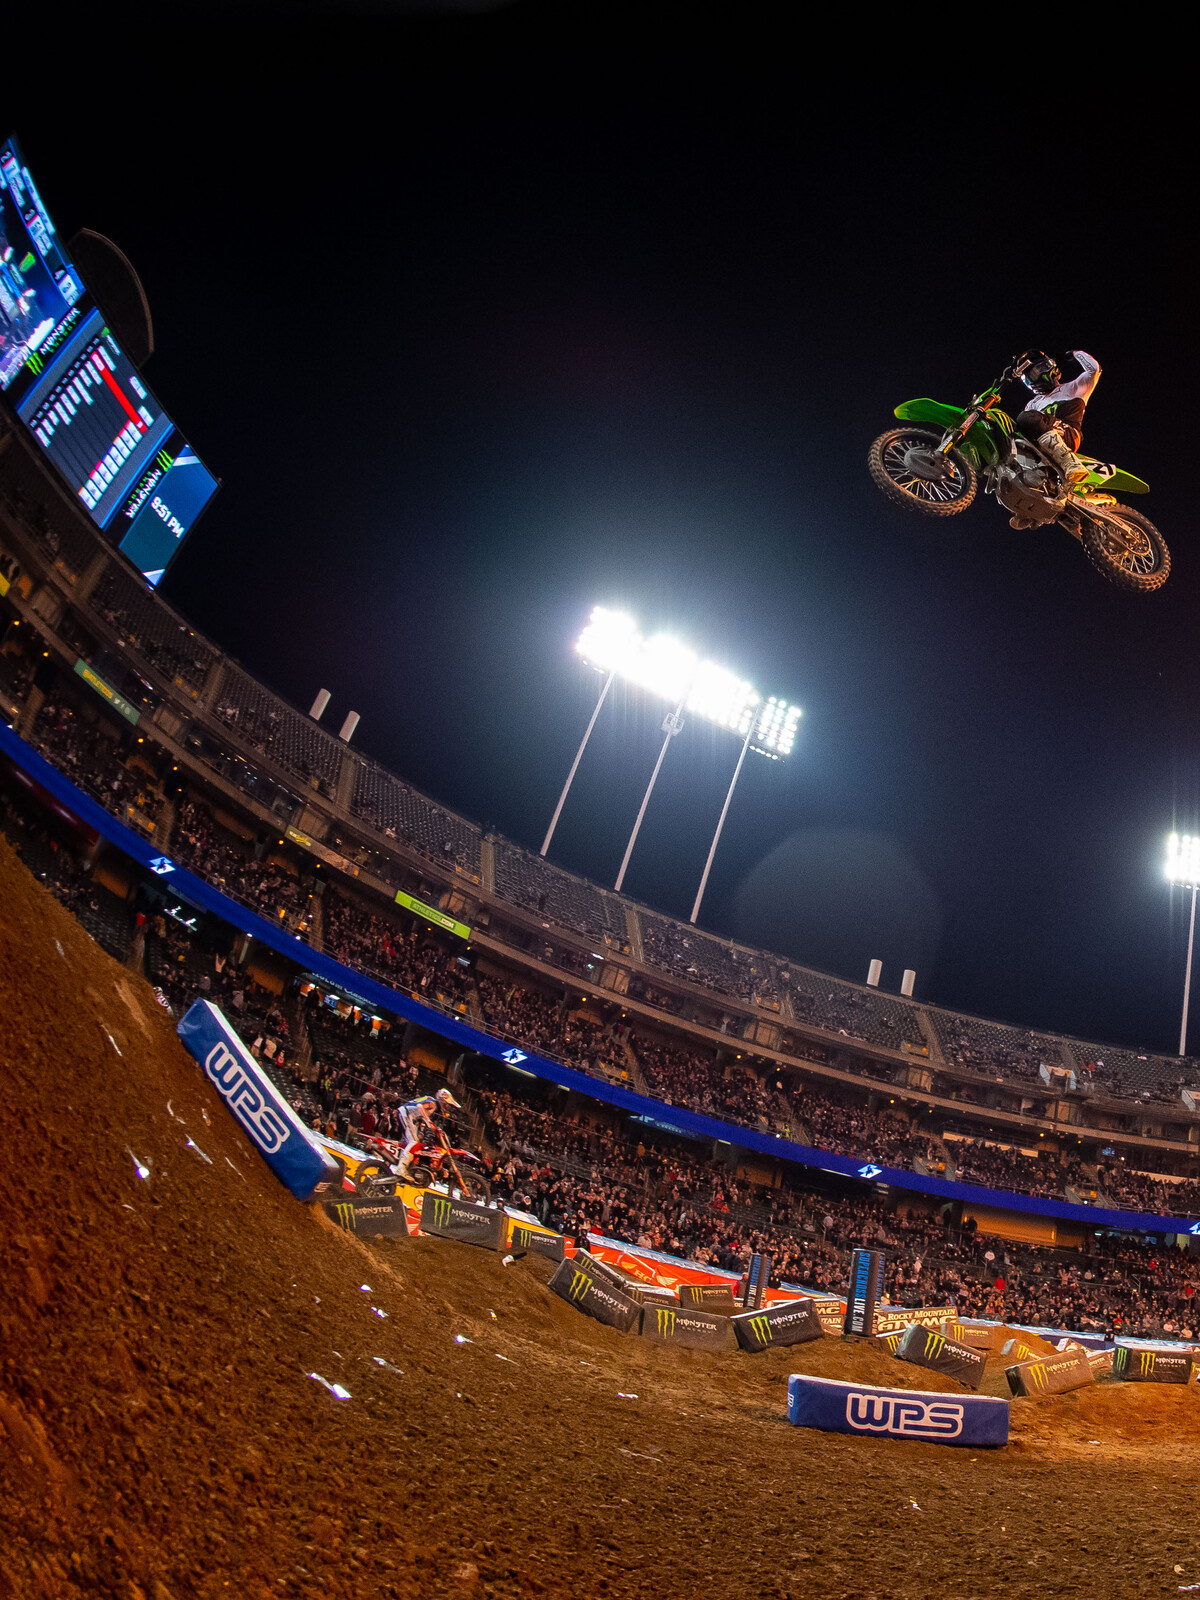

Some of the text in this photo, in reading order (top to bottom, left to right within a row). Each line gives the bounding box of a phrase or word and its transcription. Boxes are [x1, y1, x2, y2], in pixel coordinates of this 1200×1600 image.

[167, 516, 185, 538] PM
[205, 1041, 290, 1154] WPS
[354, 1206, 394, 1215] MONSTER
[451, 1208, 491, 1225] MONSTER
[590, 1285, 629, 1314] MONSTER
[851, 1251, 871, 1333] SUPERCROSSLIVE.COM
[769, 1310, 809, 1325] MONSTER
[888, 1308, 956, 1321] ROCKY MOUNTAIN
[676, 1318, 718, 1331] MONSTER
[943, 1343, 981, 1363] MONSTER
[1046, 1358, 1081, 1372] MONSTER
[846, 1392, 964, 1438] WPS
